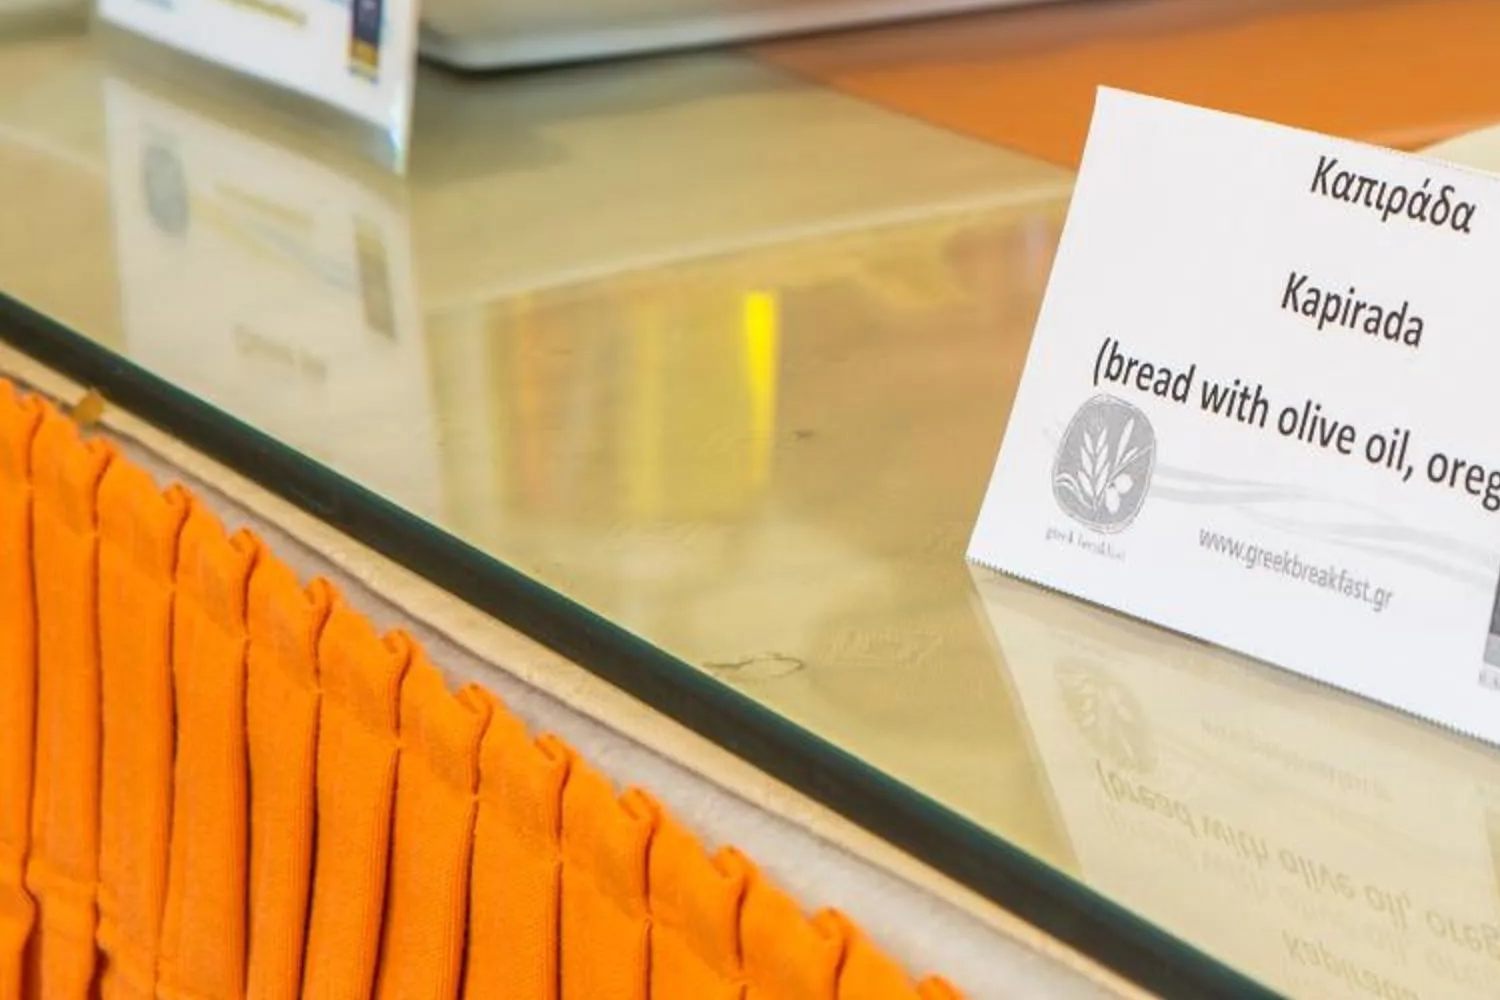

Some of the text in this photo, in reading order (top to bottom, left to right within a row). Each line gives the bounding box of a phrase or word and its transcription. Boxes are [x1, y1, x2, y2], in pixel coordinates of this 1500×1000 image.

[1311, 156, 1476, 233] Καπιράδα
[1281, 272, 1423, 347] Kapirada
[1093, 337, 1196, 403] (bread
[1201, 379, 1269, 428] with
[1278, 400, 1356, 455] olive
[1365, 428, 1413, 481] oil,
[1198, 528, 1394, 613] www.greekbreakfast.gr
